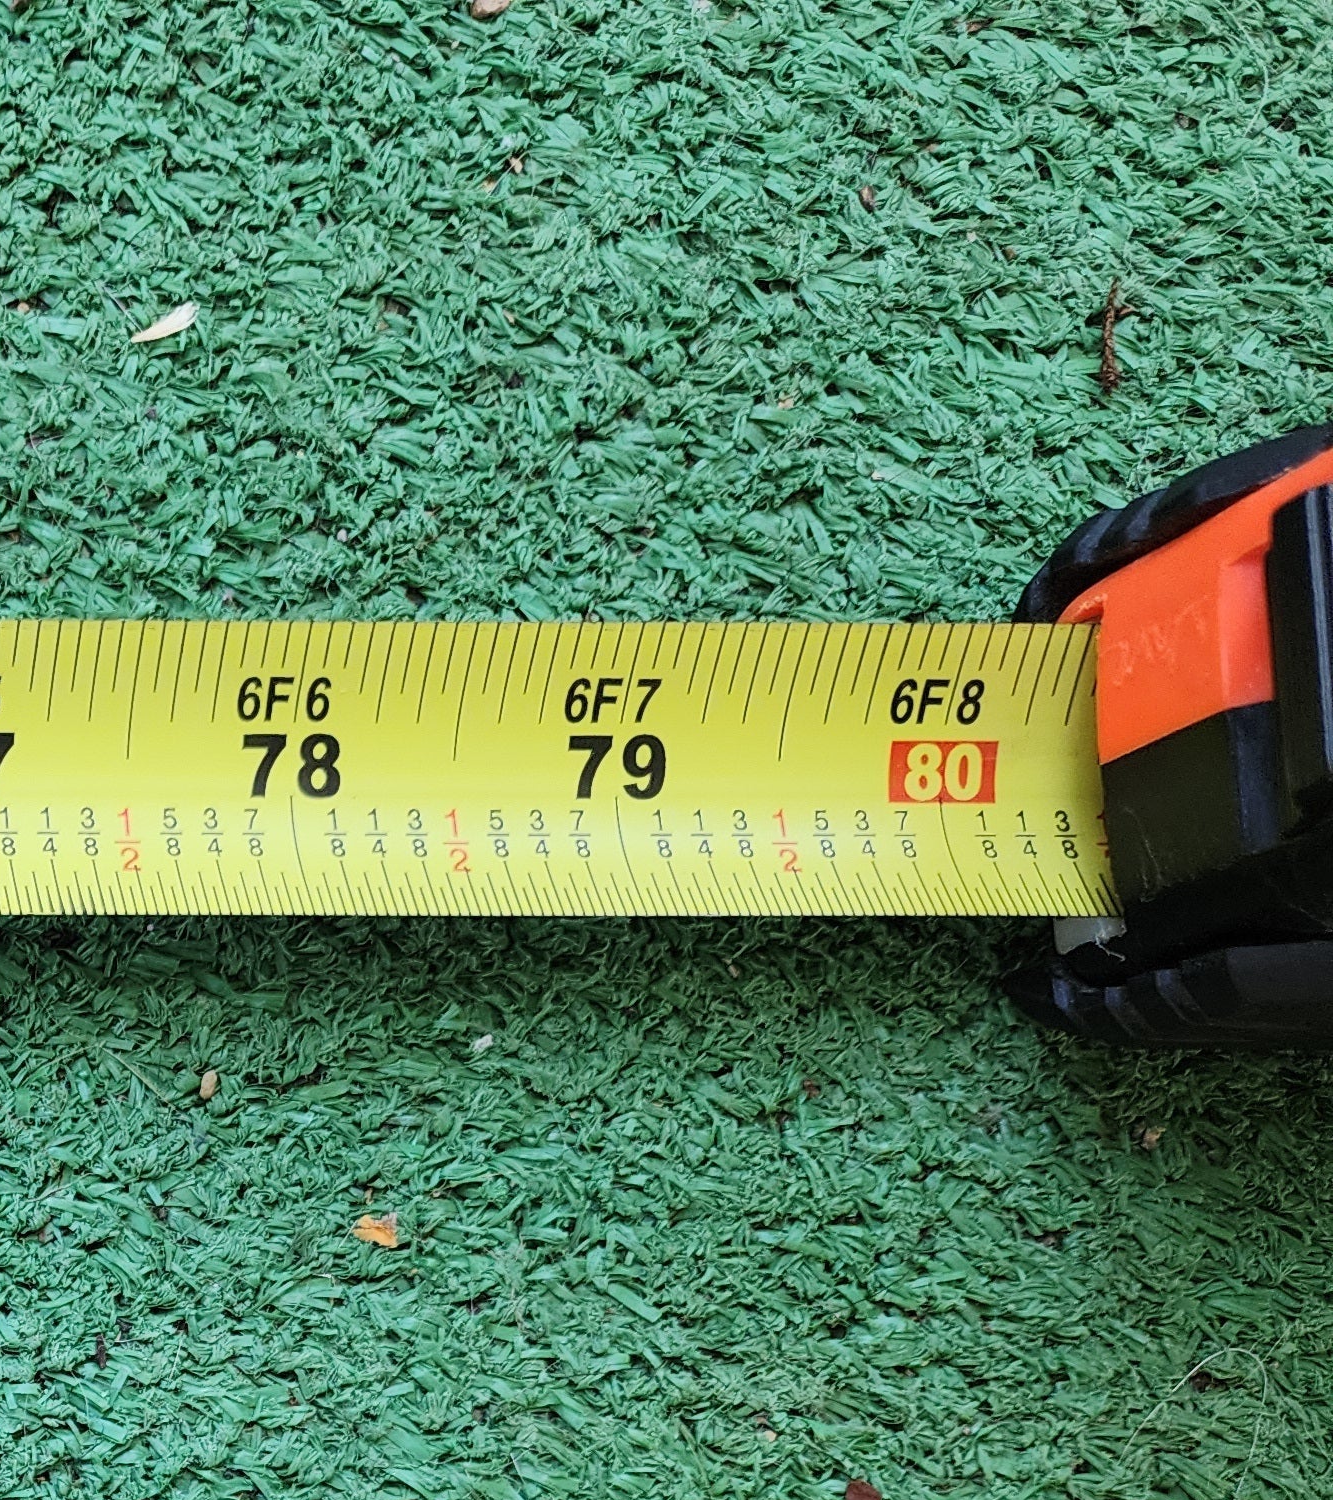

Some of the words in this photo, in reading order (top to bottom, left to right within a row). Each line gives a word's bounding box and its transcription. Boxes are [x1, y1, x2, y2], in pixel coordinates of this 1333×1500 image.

[241, 734, 342, 798] 78
[567, 735, 666, 799] 79
[903, 743, 984, 801] 80
